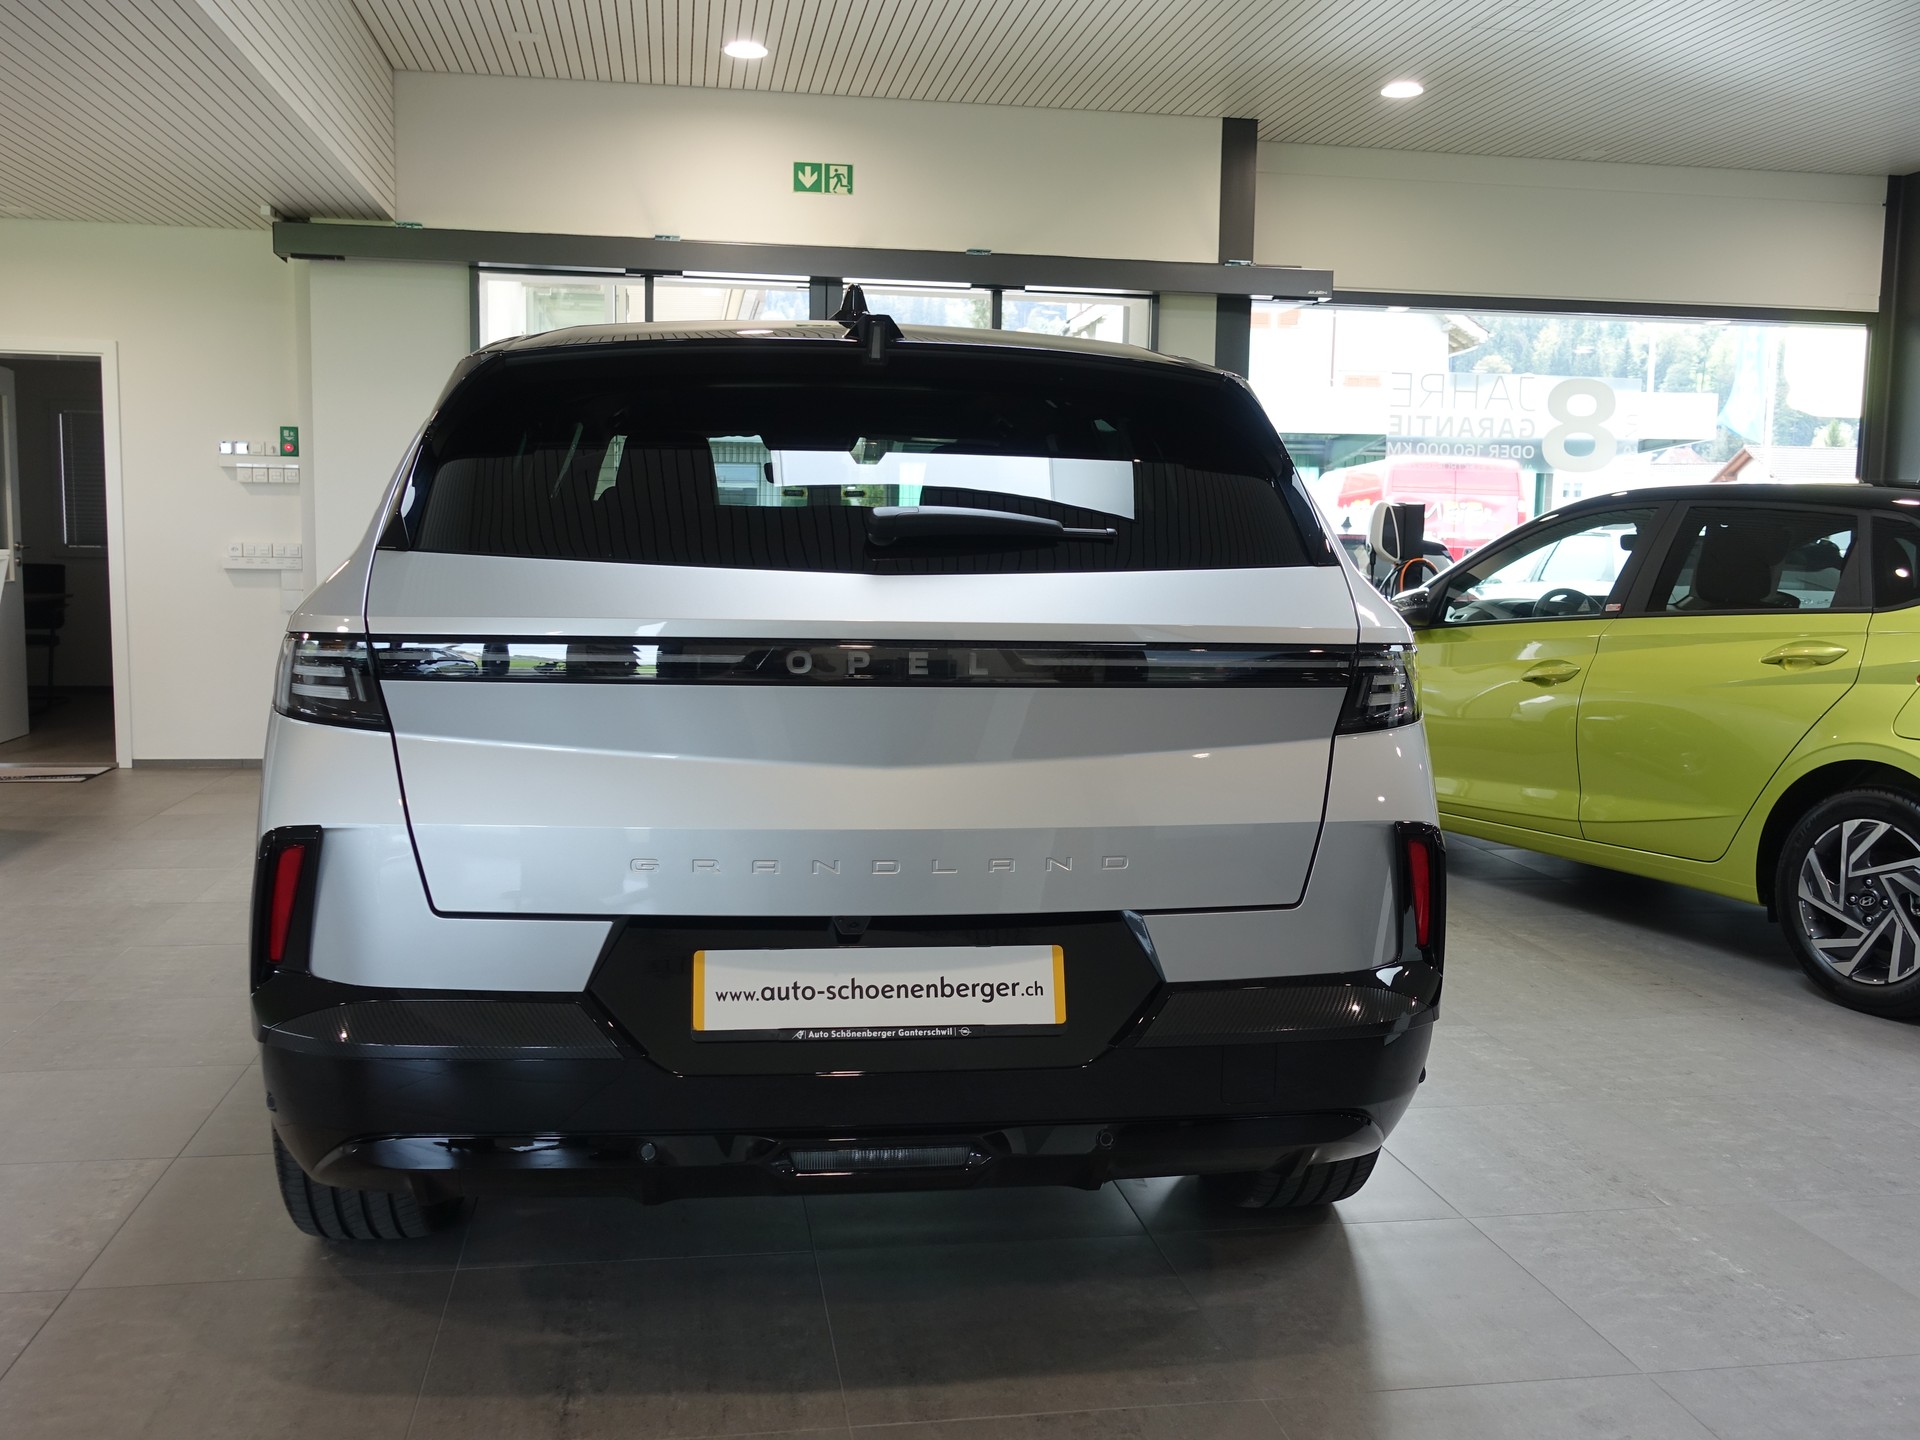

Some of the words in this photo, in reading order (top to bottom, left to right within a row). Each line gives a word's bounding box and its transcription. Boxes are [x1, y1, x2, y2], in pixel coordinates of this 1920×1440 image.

[785, 650, 989, 676] OPEL
[629, 854, 1130, 876] GRANDLAND
[715, 976, 1044, 1003] www.auto-schoenenberger.ch
[808, 1030, 829, 1039] Auto
[831, 1028, 896, 1039] Schönenberger
[898, 1027, 953, 1037] Ganterschwil
